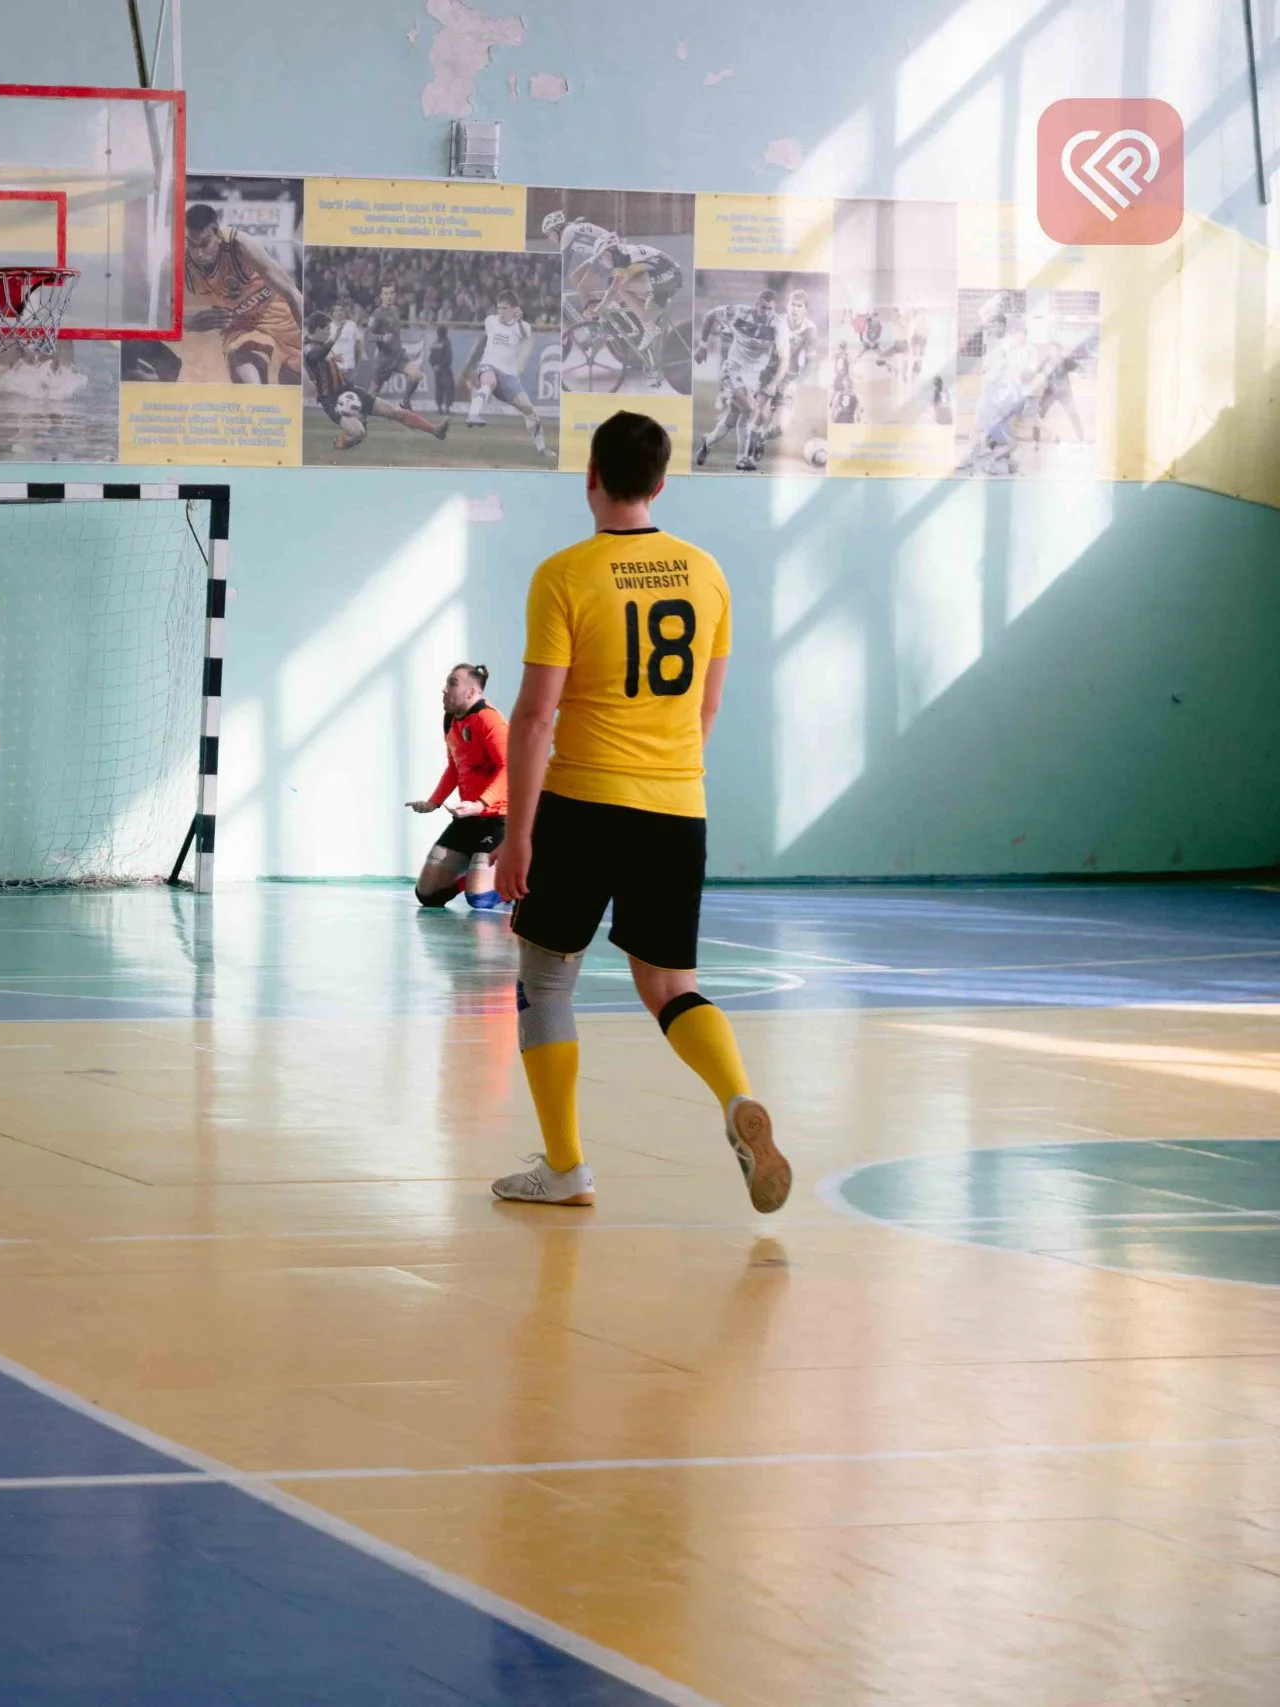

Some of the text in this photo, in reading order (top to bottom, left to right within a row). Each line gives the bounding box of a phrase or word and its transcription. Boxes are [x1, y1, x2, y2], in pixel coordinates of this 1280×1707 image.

[236, 286, 272, 314] ALUTE
[610, 559, 688, 574] PEREIASLAV
[615, 573, 689, 589] UNIVERSITY
[624, 598, 696, 698] 18
